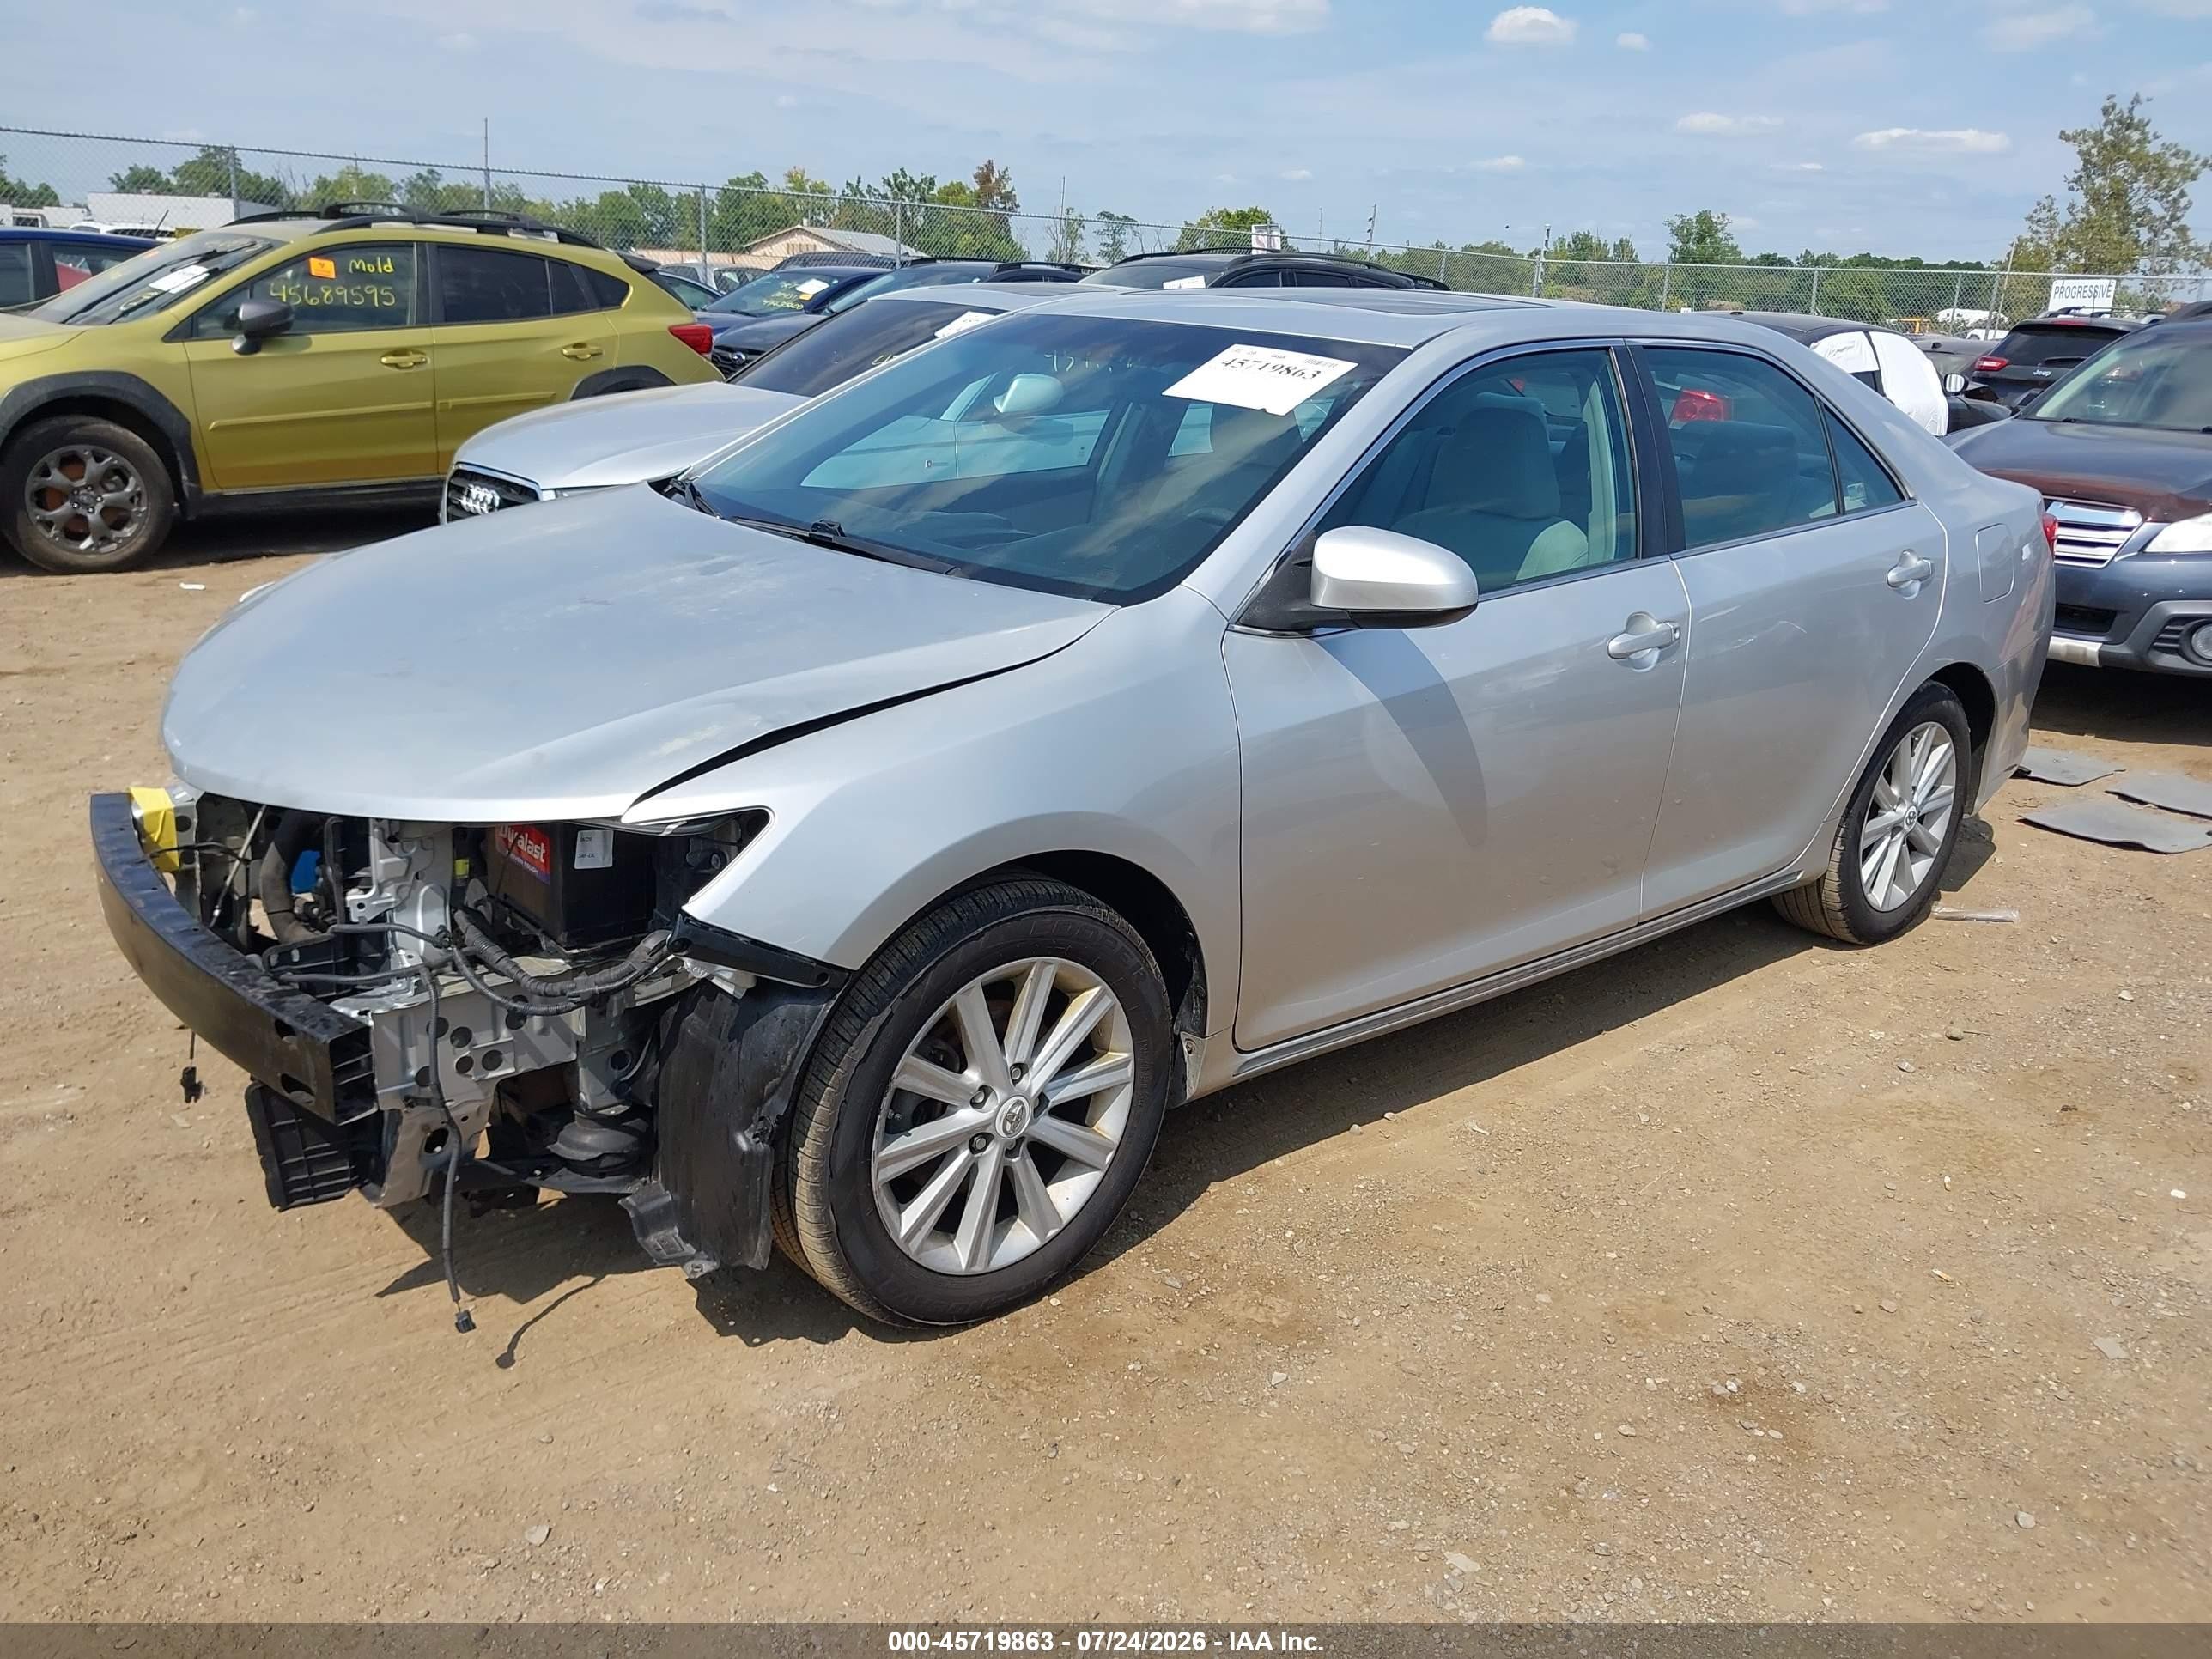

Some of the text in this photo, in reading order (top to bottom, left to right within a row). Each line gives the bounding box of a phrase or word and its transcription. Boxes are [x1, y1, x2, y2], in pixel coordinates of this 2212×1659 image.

[349, 257, 394, 274] Mold
[270, 283, 396, 307] 45689595
[2053, 284, 2113, 299] PROGRESSIVE
[1221, 357, 1322, 380] 45719863
